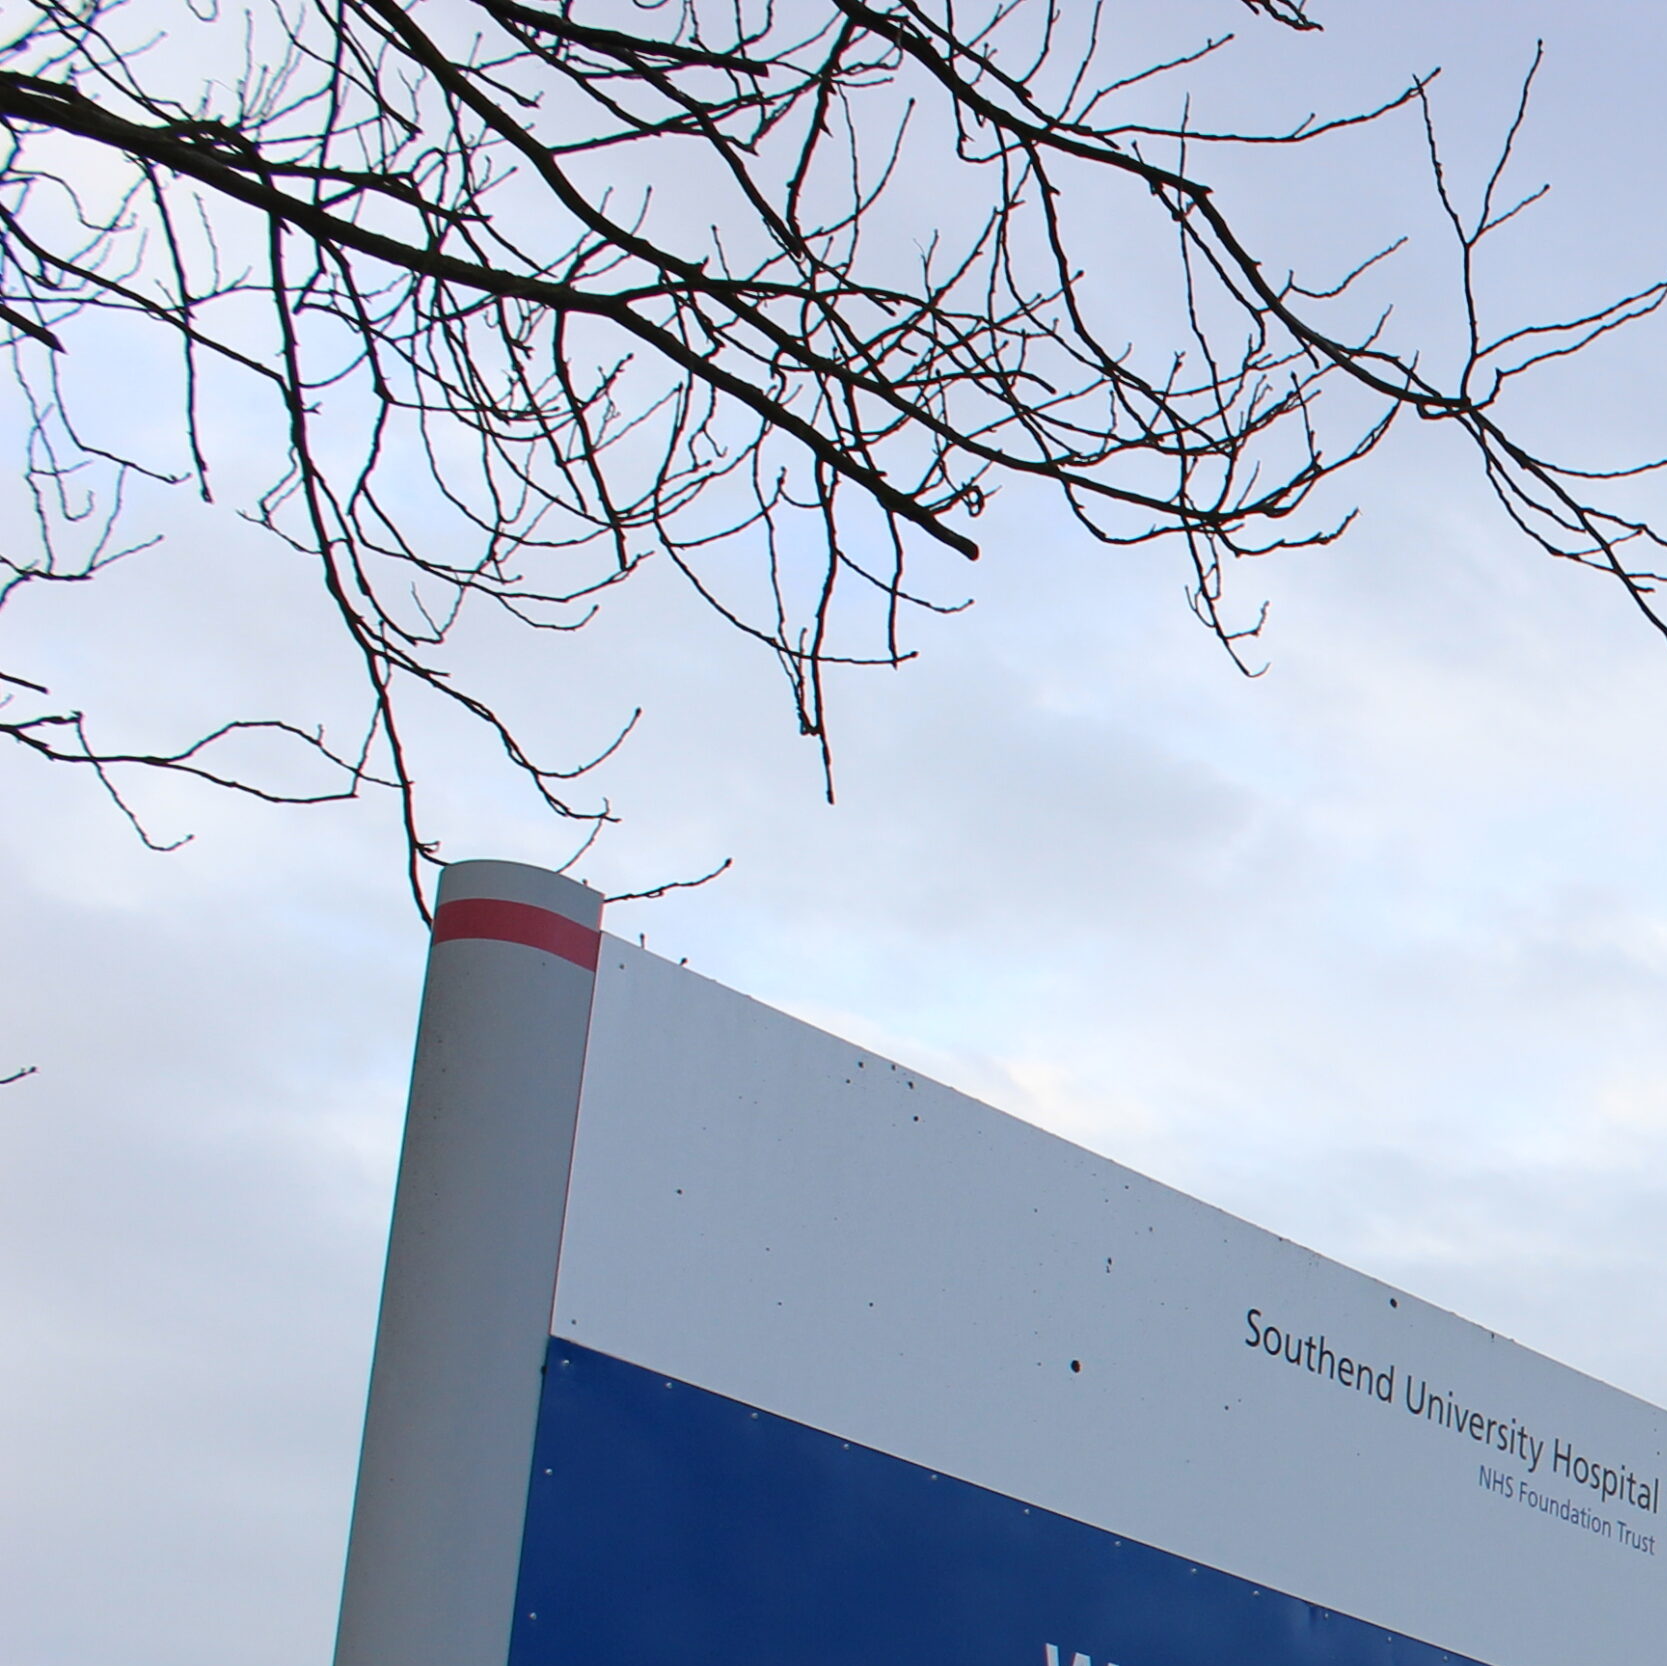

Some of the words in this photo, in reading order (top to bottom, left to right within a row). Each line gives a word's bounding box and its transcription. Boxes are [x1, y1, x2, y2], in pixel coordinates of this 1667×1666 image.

[1244, 1308, 1395, 1404] Southend
[1406, 1375, 1544, 1474] University
[1552, 1437, 1660, 1514] Hospital
[1478, 1464, 1515, 1499] NHS
[1519, 1481, 1612, 1539] Foundation
[1616, 1518, 1656, 1556] Trust
